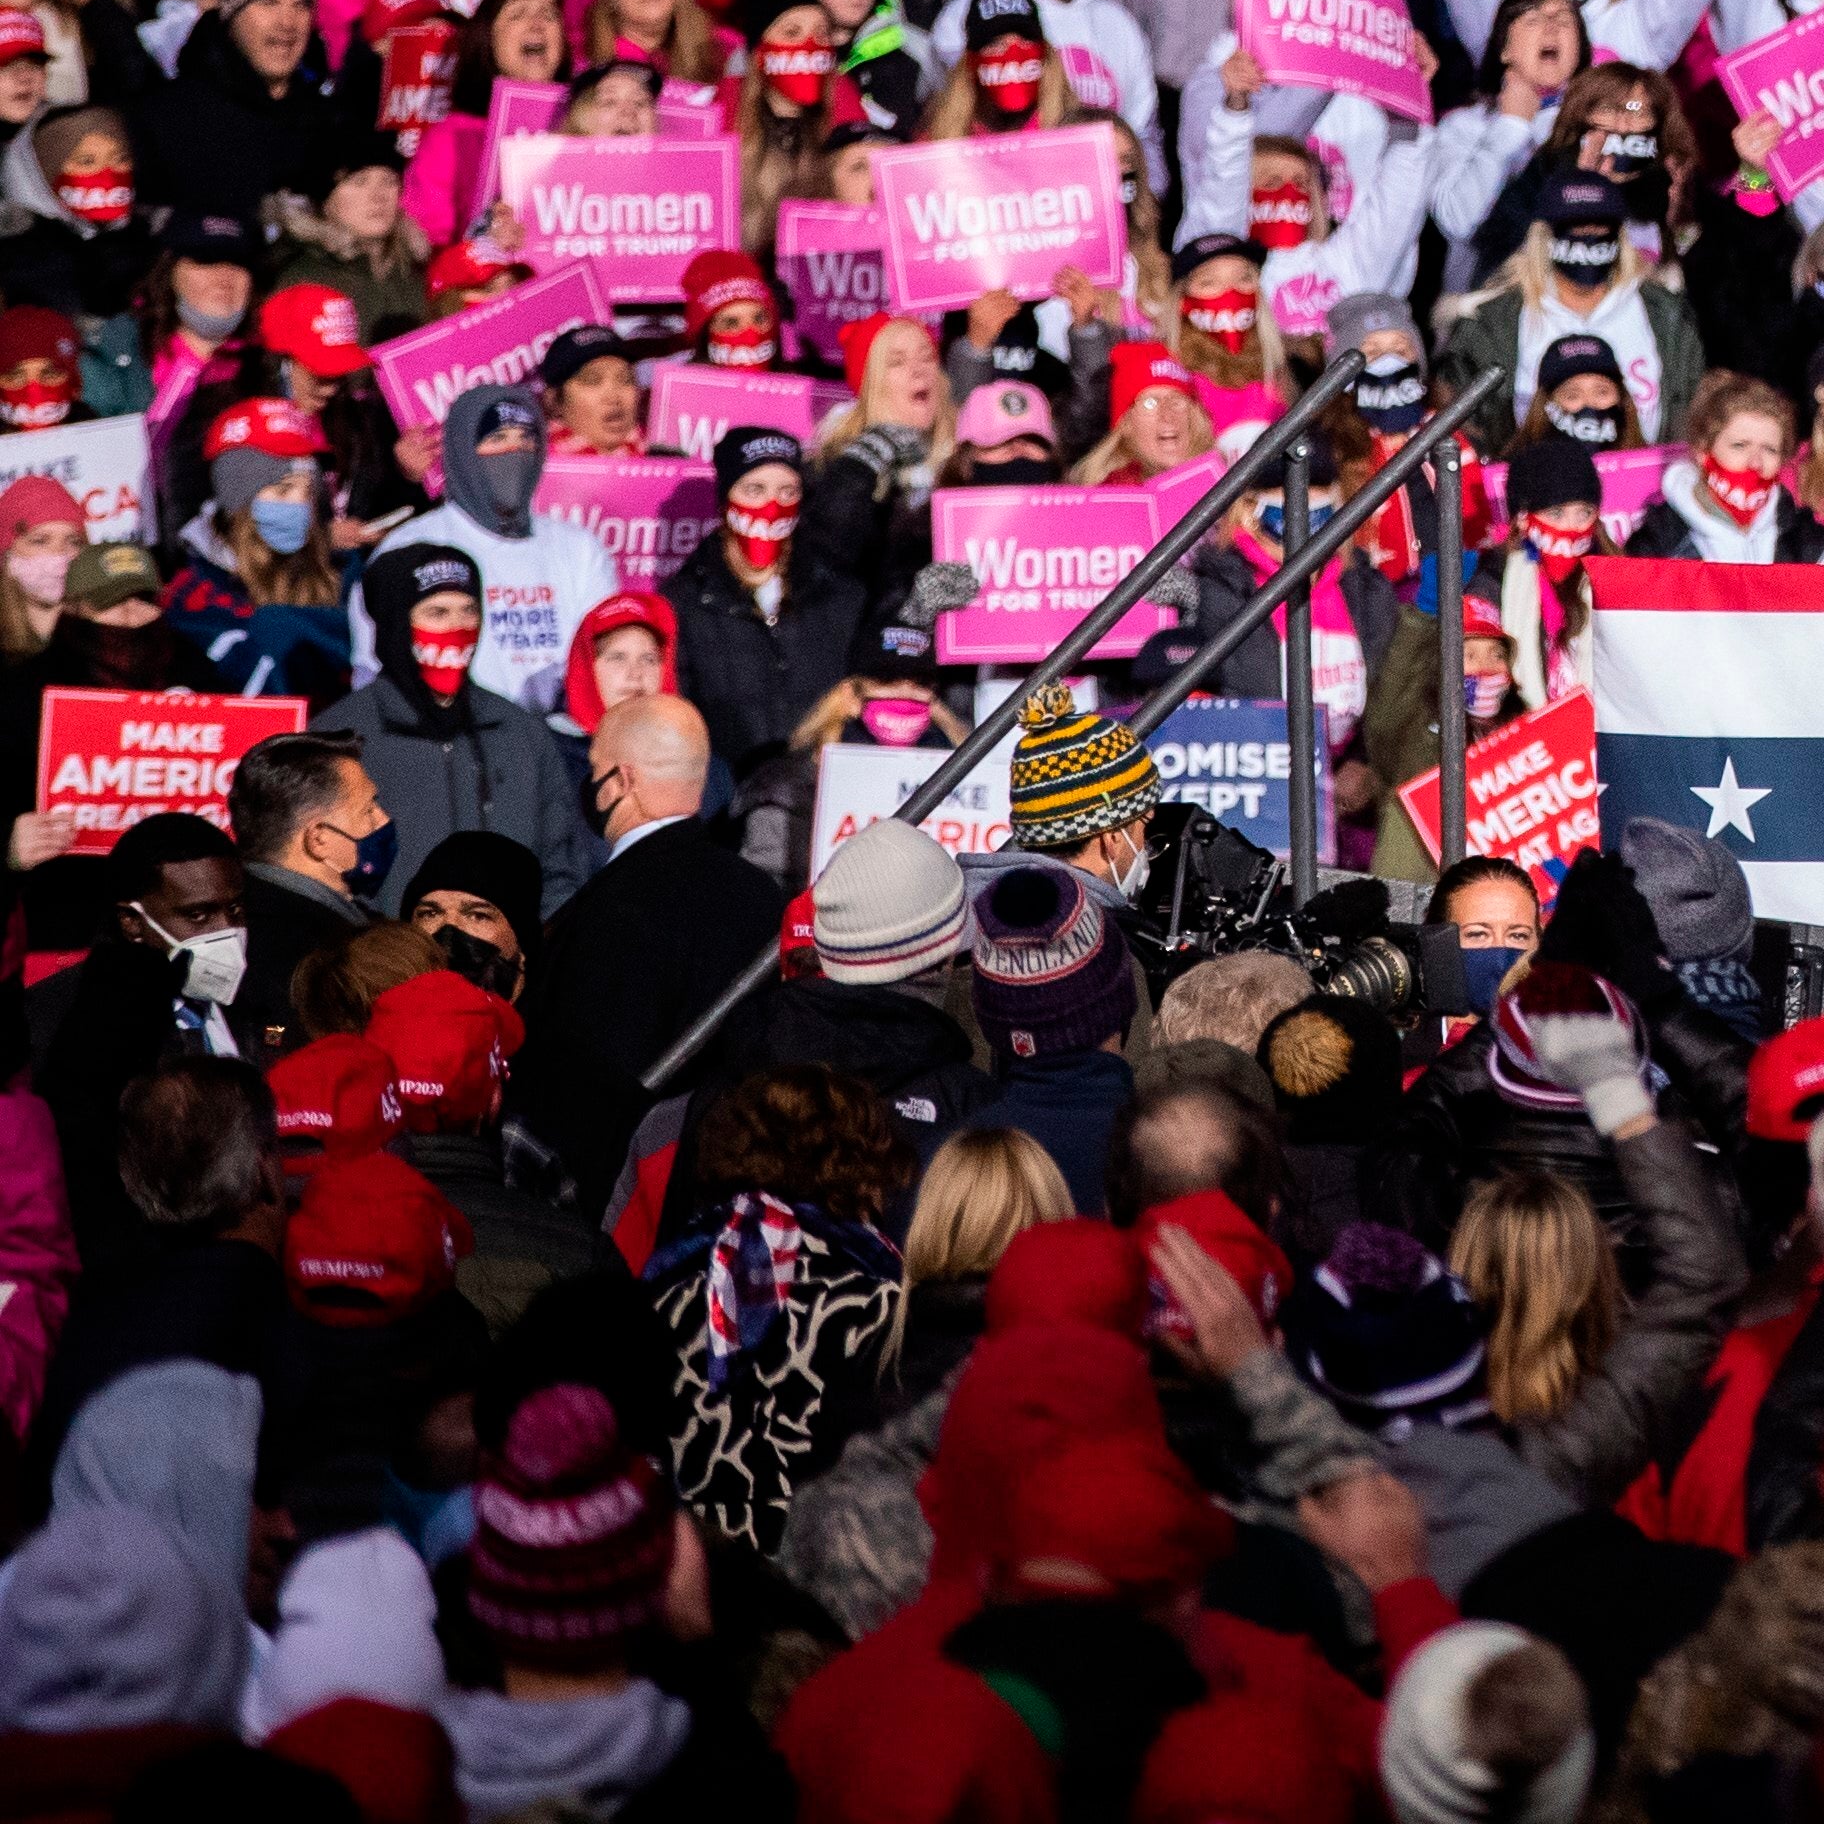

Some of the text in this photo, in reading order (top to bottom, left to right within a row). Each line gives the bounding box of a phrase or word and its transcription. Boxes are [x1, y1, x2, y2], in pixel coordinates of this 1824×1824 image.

[1278, 23, 1408, 70] FOR TRUMP
[531, 183, 713, 232] Women
[905, 182, 1094, 239] Women
[555, 236, 695, 255] FOR TRUMP
[933, 230, 1071, 262] FOR TRUMP
[964, 538, 1149, 589] Women
[486, 585, 552, 605] FOUR
[986, 585, 1103, 611] FOR TRU
[491, 609, 556, 625] MORE
[496, 633, 558, 649] YEARS
[122, 722, 224, 753] MAKE
[1152, 742, 1318, 779] OMISE
[1469, 739, 1555, 803] MAKE
[50, 759, 236, 800] AMERIC
[1466, 761, 1599, 851] MERIC
